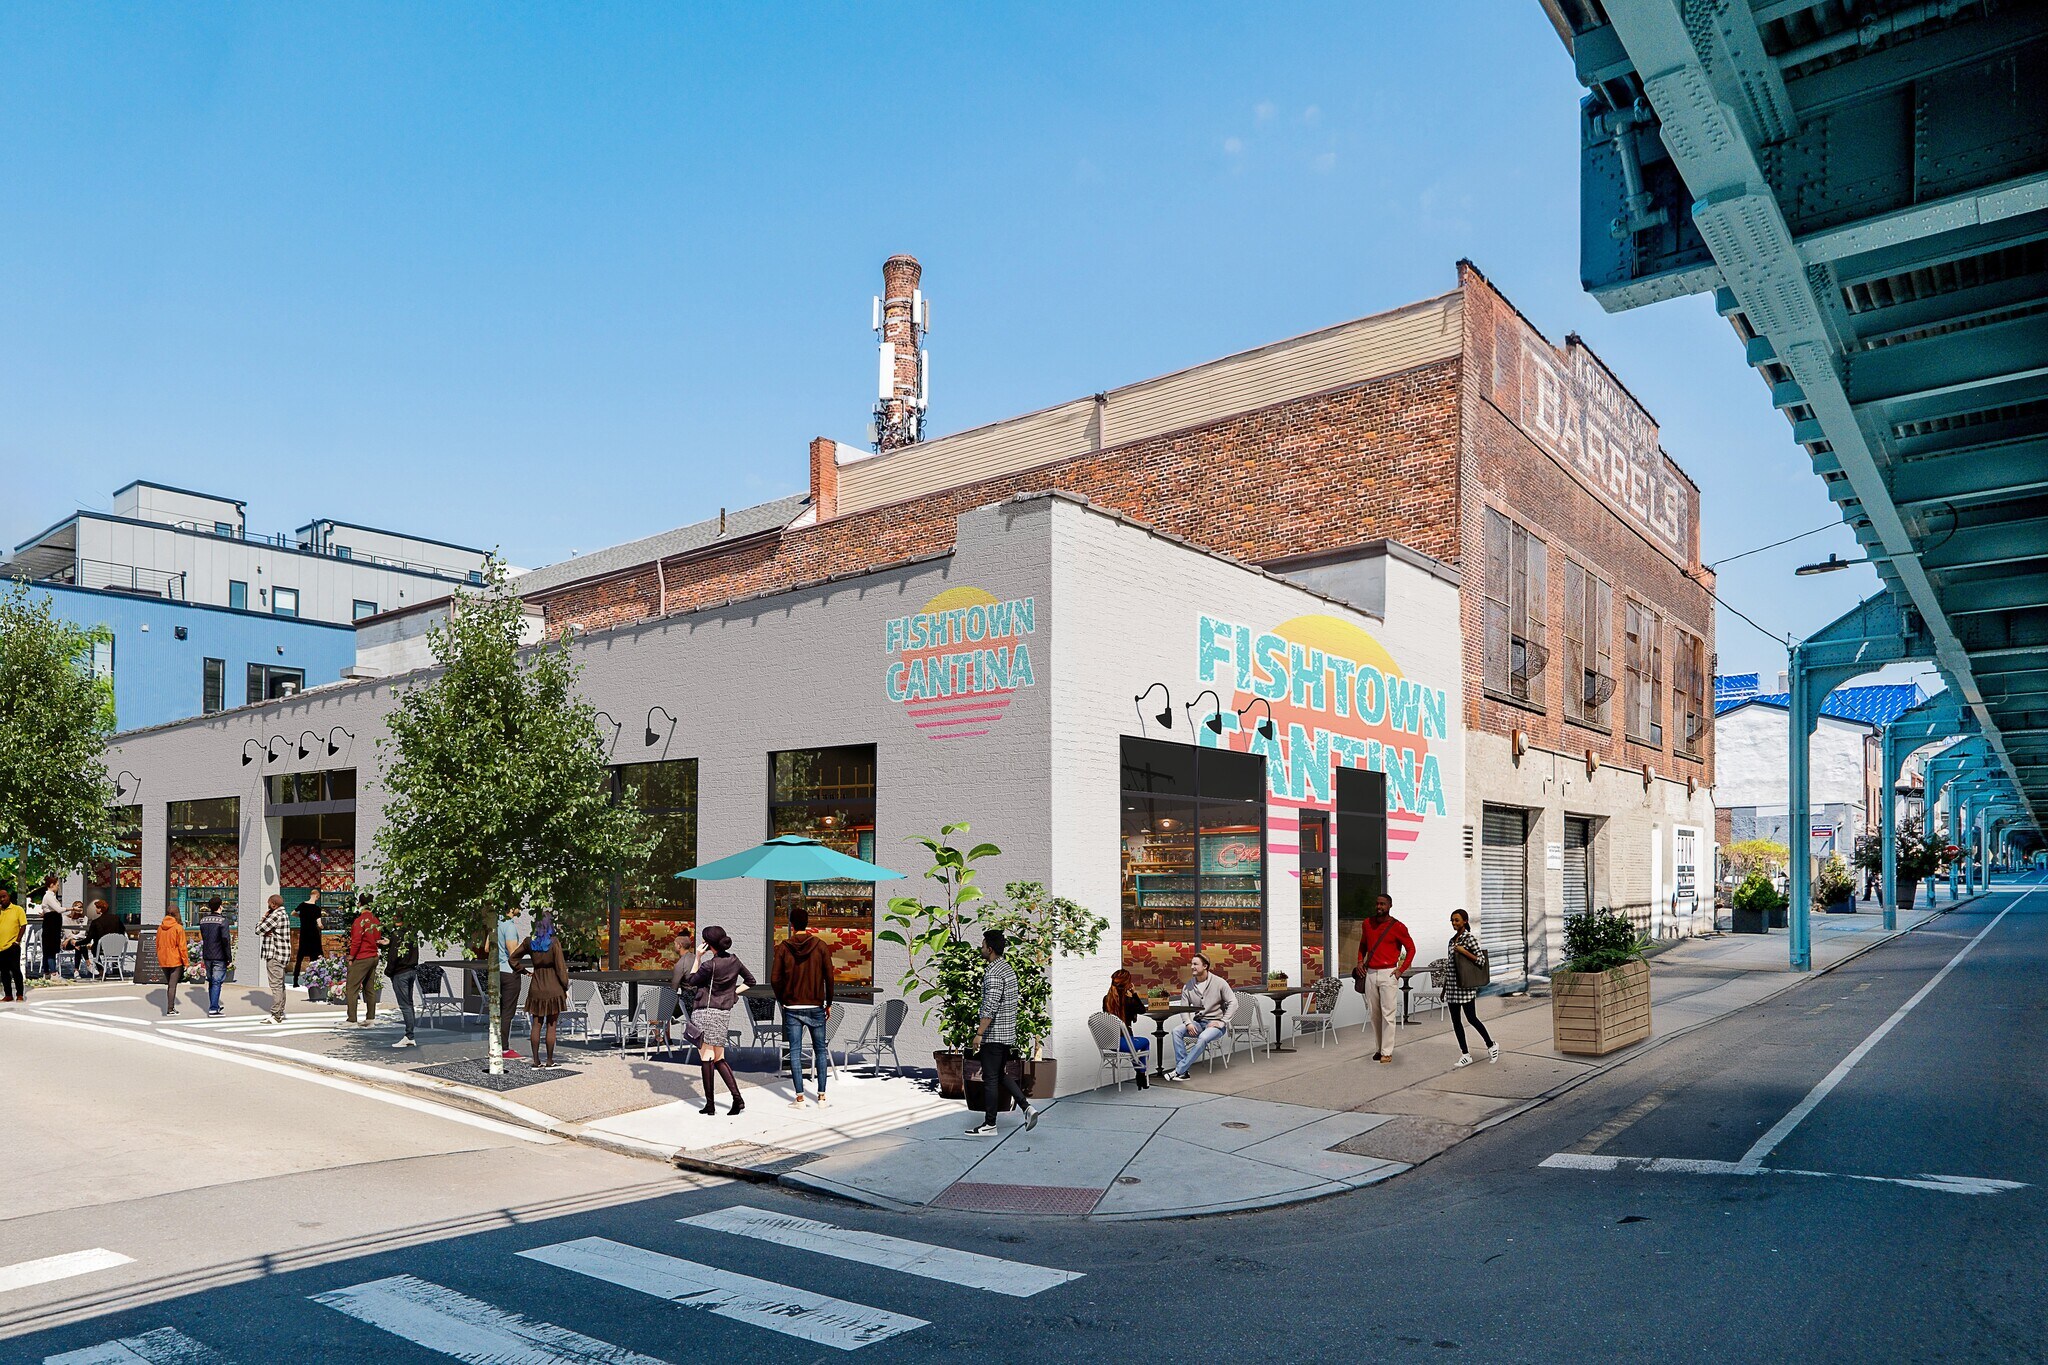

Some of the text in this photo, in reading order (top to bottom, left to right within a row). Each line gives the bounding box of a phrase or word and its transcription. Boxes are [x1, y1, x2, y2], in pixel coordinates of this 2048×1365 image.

[1536, 366, 1679, 544] BARRELS
[886, 597, 1036, 654] FISHTOWN
[886, 644, 1036, 702] CANTINA
[1198, 613, 1448, 741] FISHTOWN
